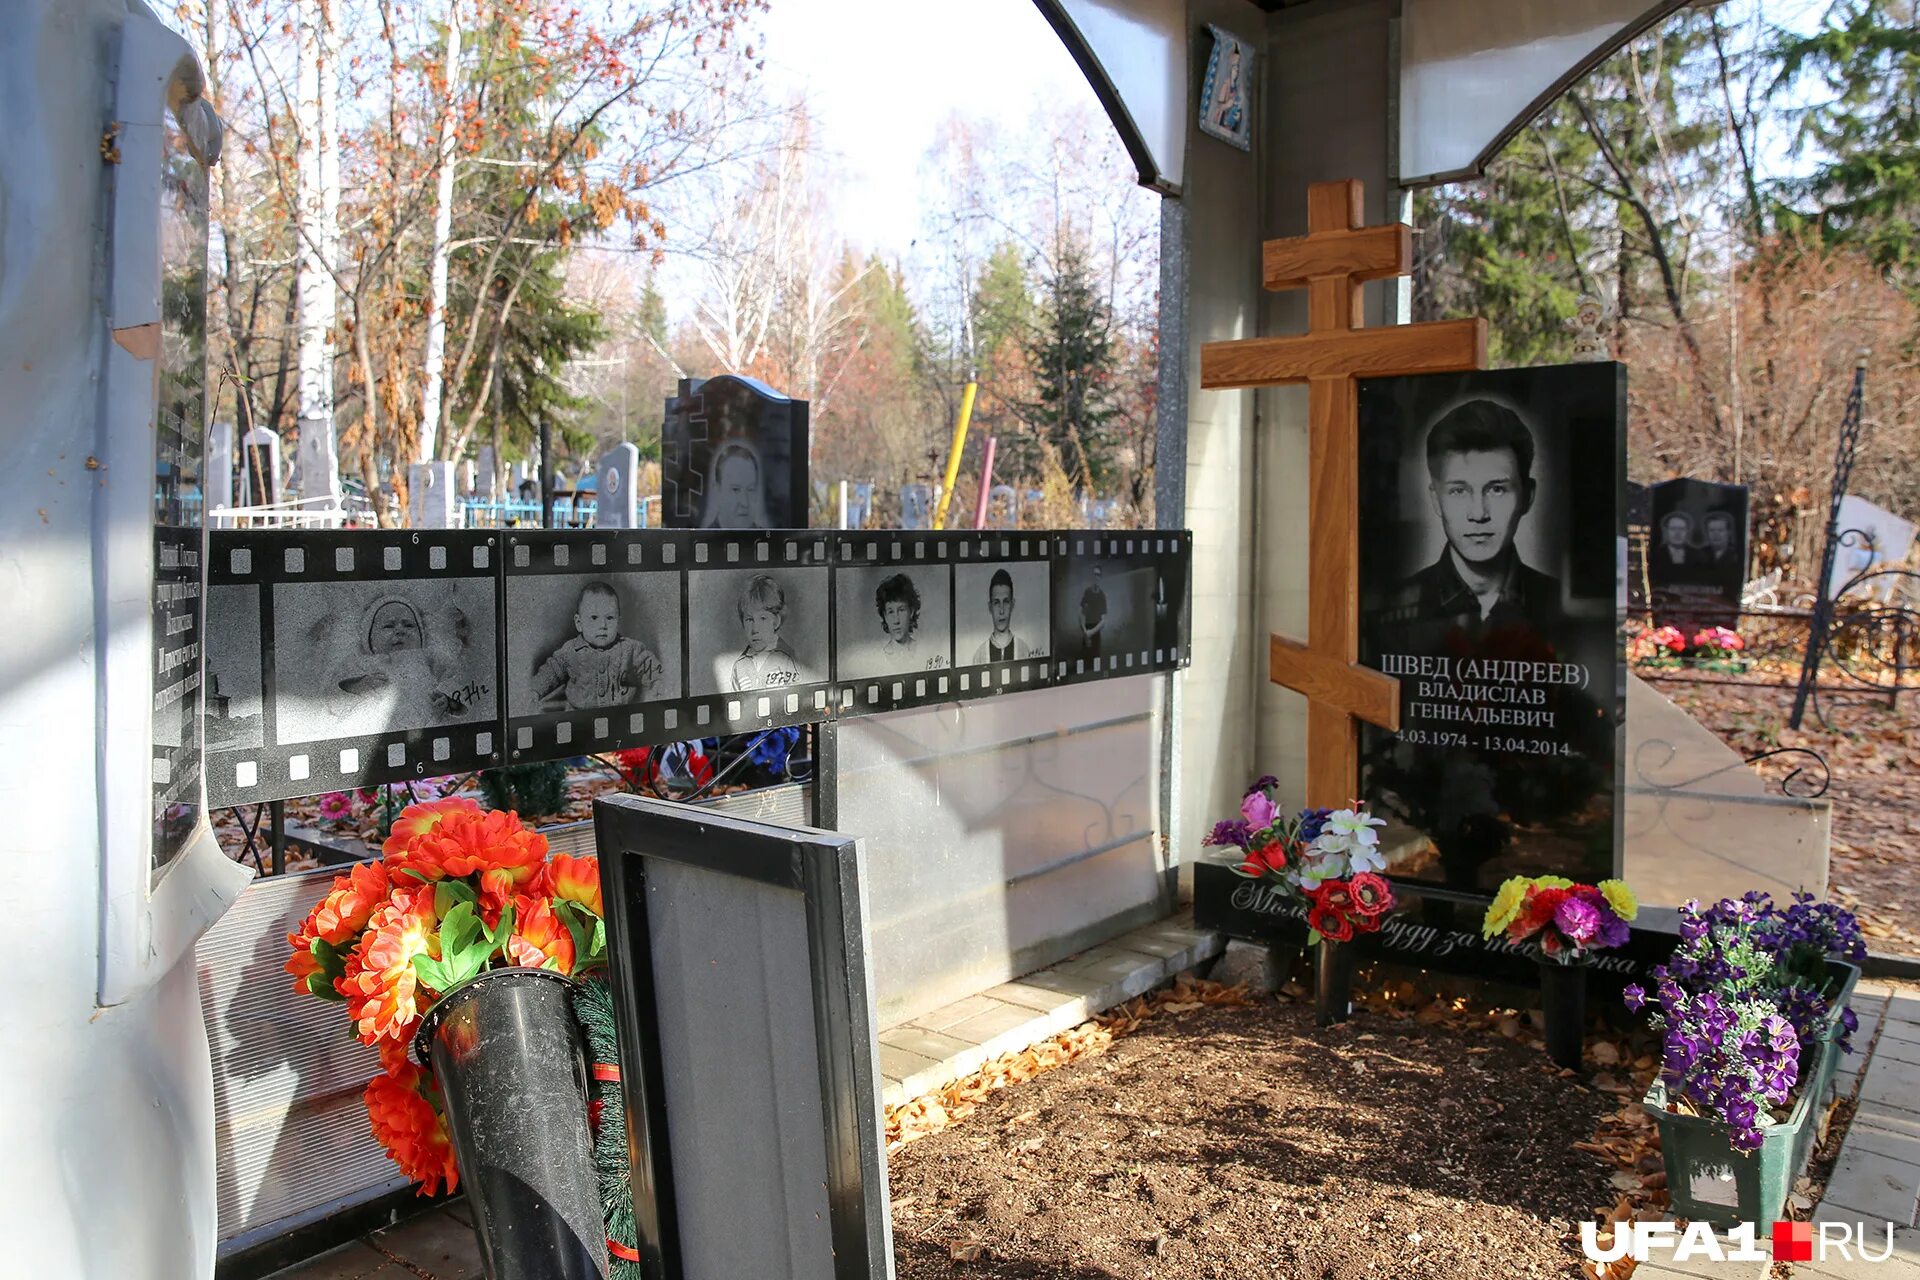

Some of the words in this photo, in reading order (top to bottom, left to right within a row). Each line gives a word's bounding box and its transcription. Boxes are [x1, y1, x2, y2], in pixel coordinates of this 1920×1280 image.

[412, 532, 420, 545] 6
[1381, 654, 1450, 680] ШВЕД
[1456, 657, 1590, 690] (АНДРЕЕВ)
[1418, 681, 1547, 705] ВЛАДИСЛАВ
[767, 718, 772, 727] 8
[1410, 702, 1556, 728] ГЕННАДЬЕВИЧ
[615, 739, 622, 749] 7
[1484, 736, 1569, 756] 13.04.2014
[416, 761, 424, 774] 6
[1381, 911, 1440, 952] буду
